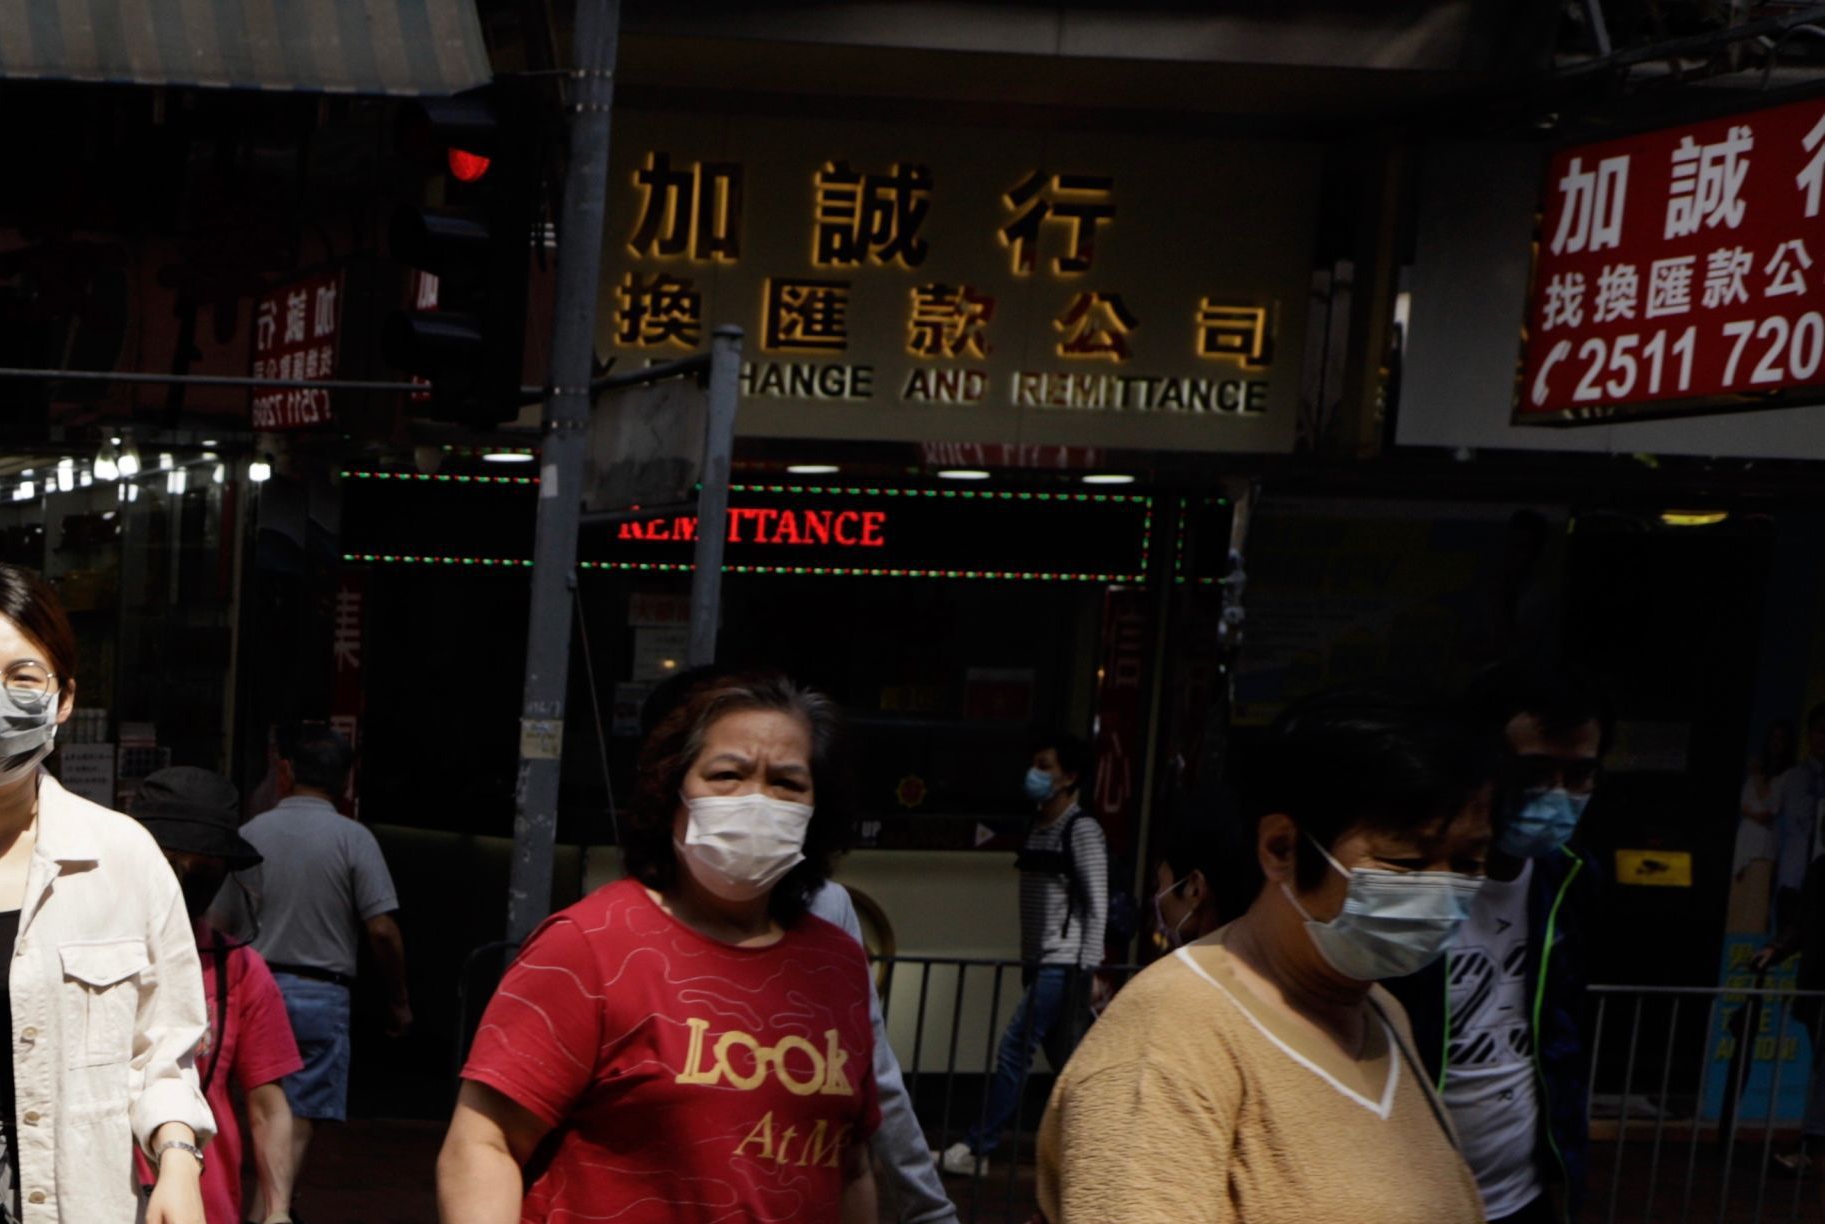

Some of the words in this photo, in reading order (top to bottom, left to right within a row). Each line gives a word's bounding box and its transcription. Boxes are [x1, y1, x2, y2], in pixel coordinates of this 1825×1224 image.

[628, 151, 1117, 275] 加誠行
[1540, 239, 1825, 332] 找換匯款公
[904, 368, 987, 404] AND
[1011, 370, 1270, 415] REMITTANCE
[1573, 327, 1697, 402] 2511
[616, 504, 888, 548] REMTTANCE
[733, 1109, 797, 1165] At
